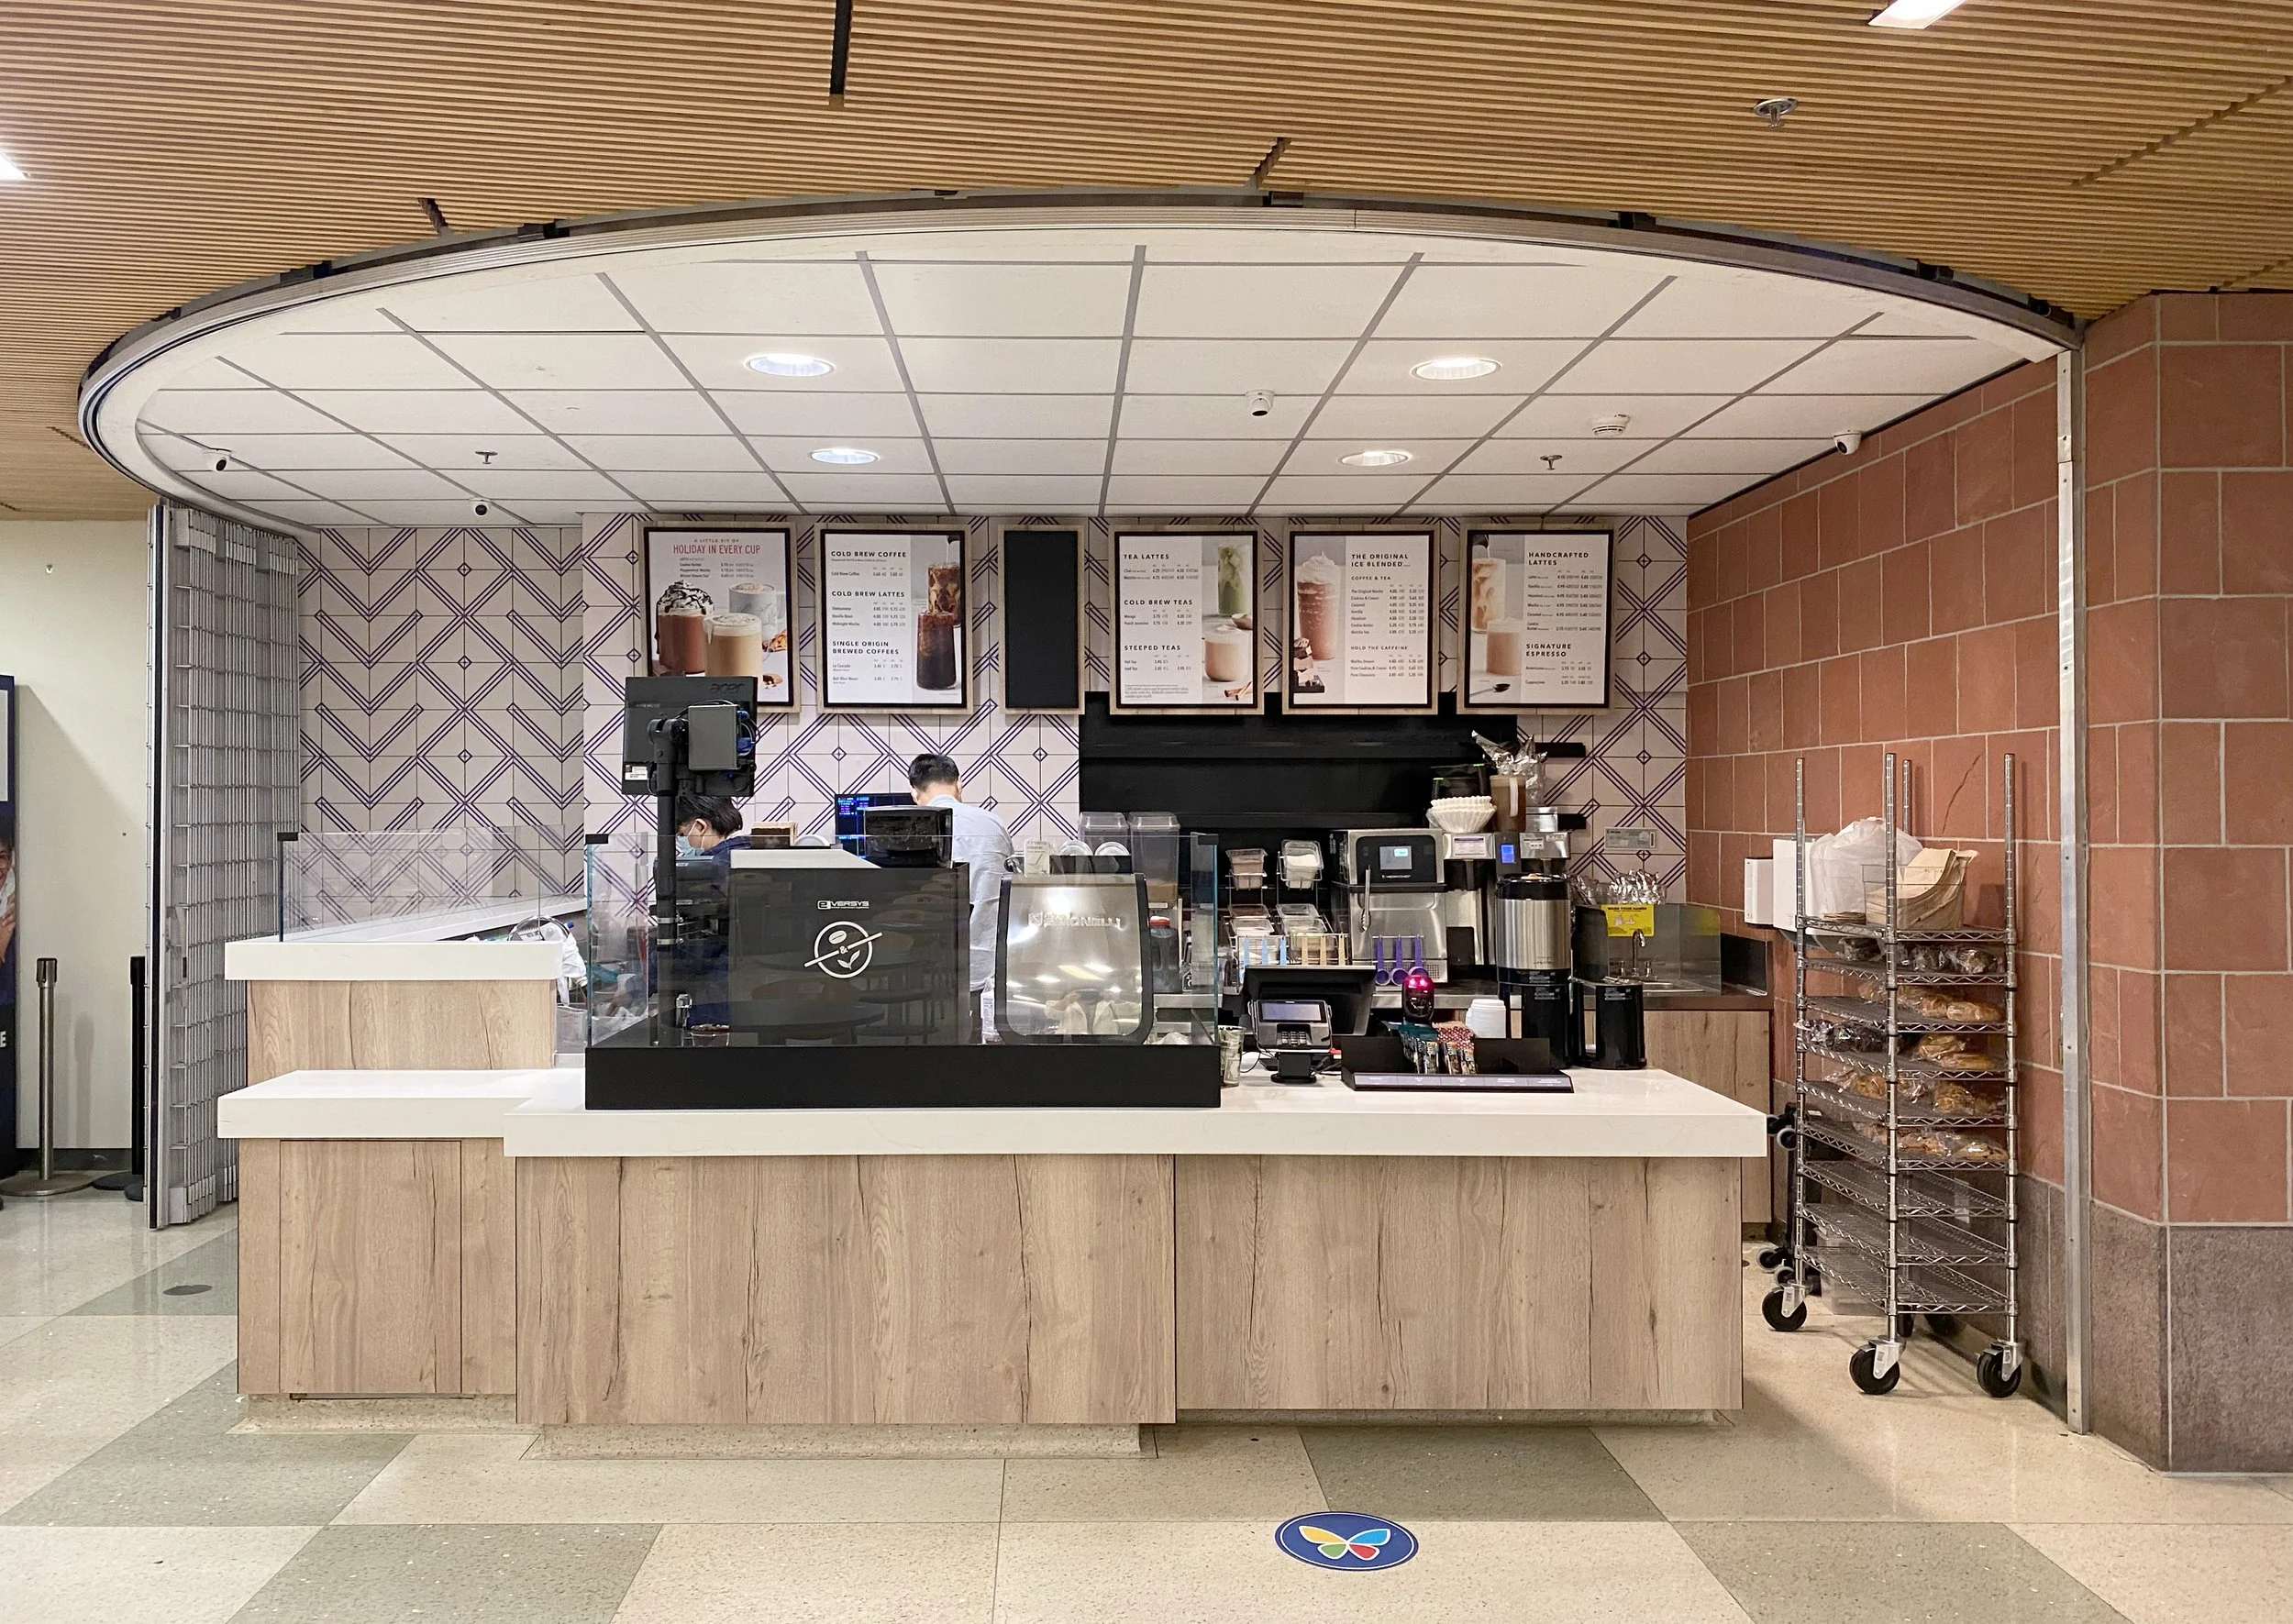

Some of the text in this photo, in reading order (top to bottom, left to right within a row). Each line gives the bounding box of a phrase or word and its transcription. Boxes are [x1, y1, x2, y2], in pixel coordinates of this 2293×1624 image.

[673, 545, 760, 554] HOLIDAY IN EVERY CUP
[710, 683, 745, 693] acer
